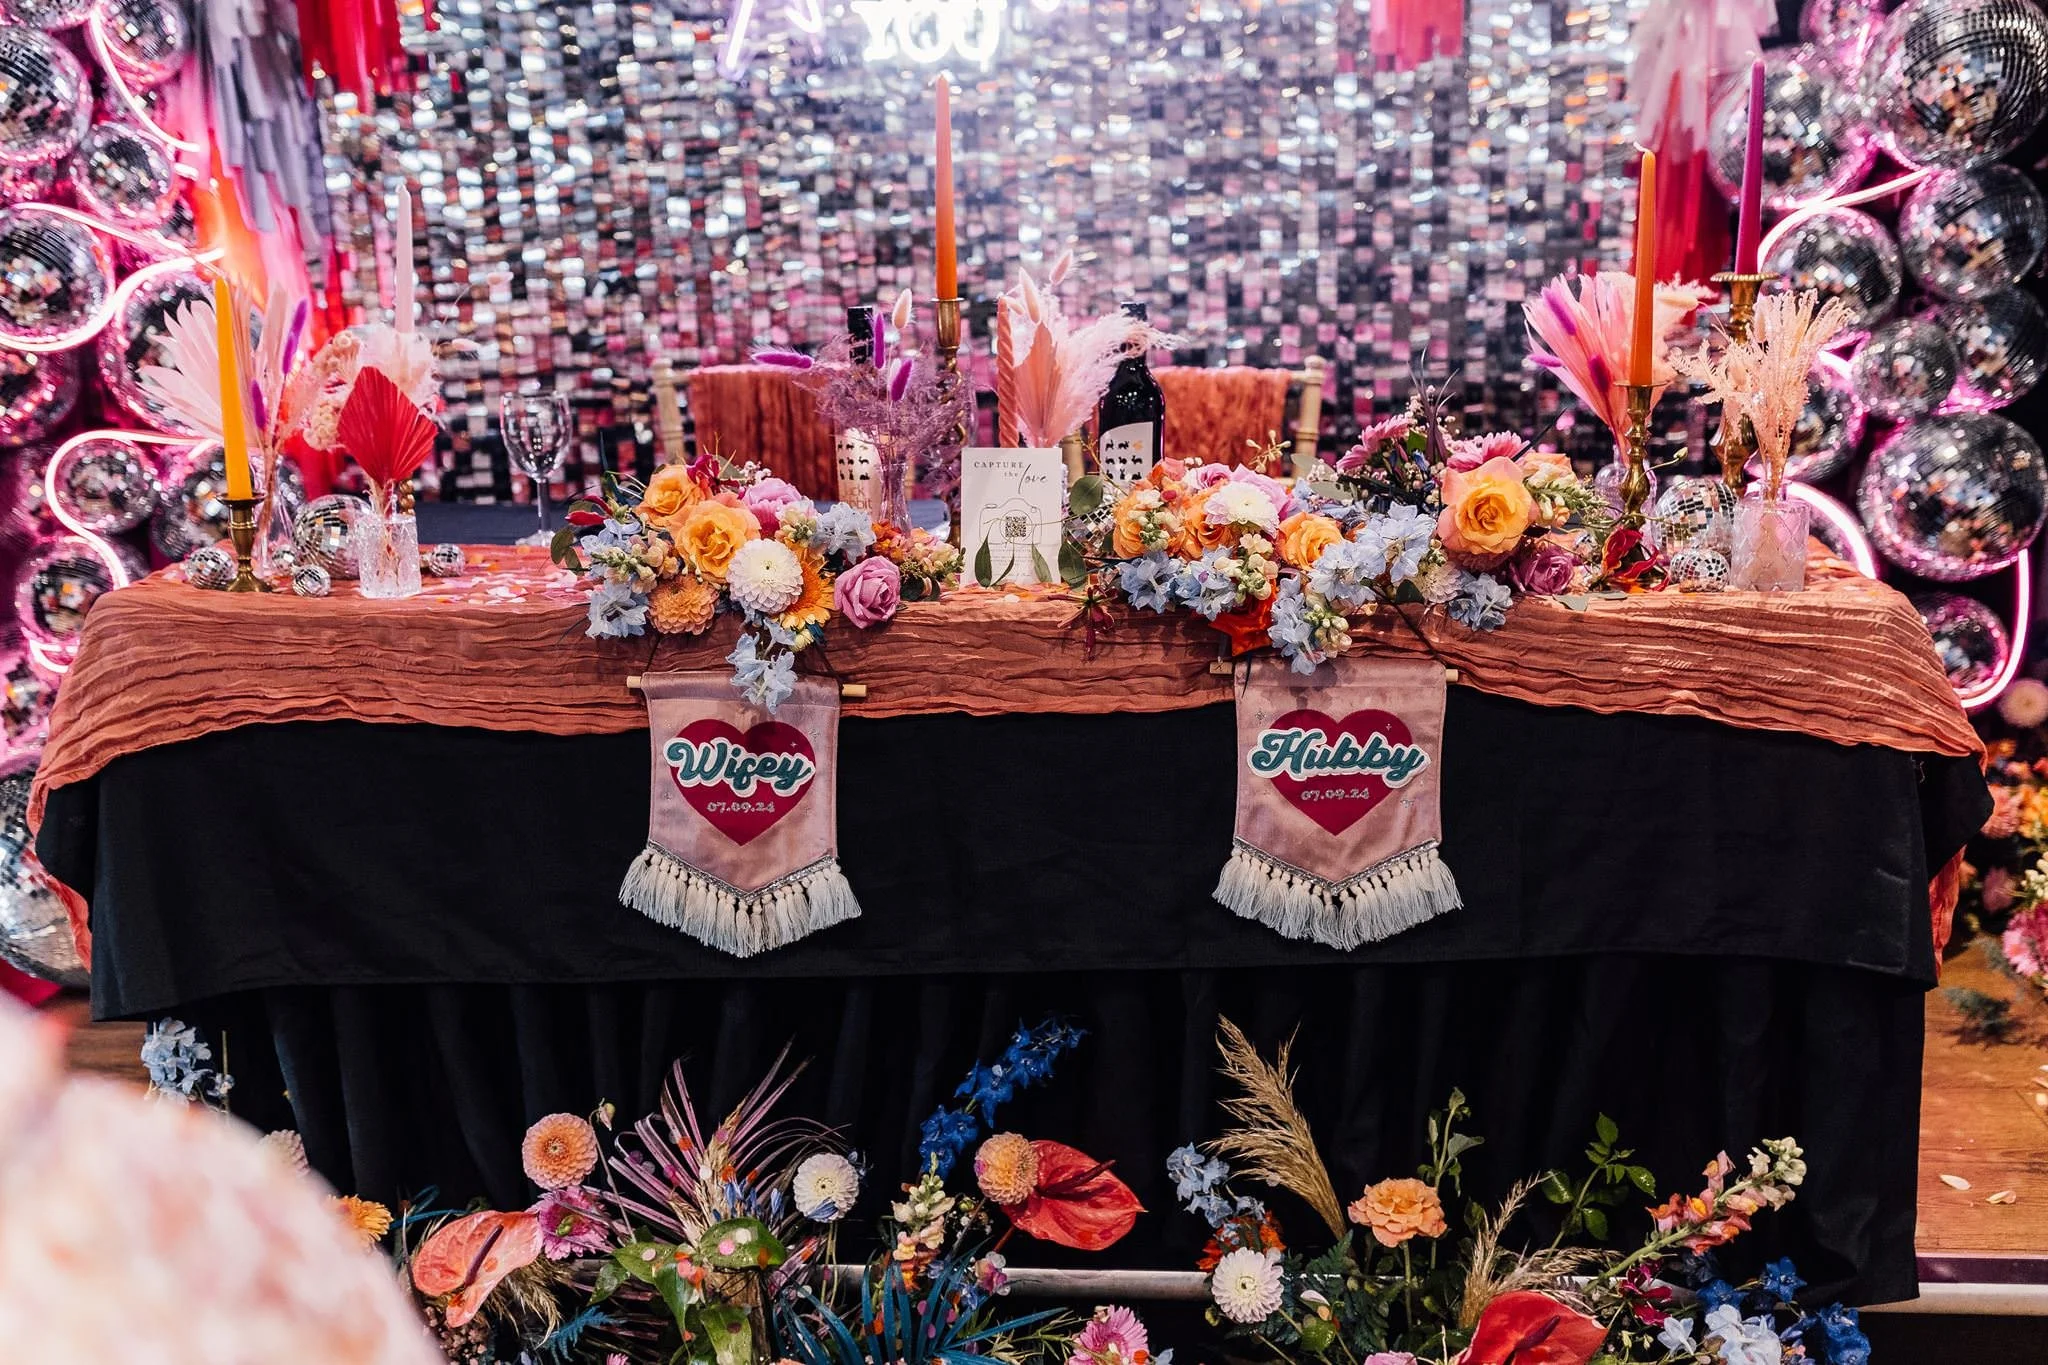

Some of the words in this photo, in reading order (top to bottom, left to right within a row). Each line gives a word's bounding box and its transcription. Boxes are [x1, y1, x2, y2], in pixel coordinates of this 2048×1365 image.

[851, 0, 1006, 72] YOU
[1018, 463, 1047, 494] love
[665, 739, 814, 794] Wifey
[1249, 728, 1428, 785] Hubby
[706, 801, 776, 813] 07.09.24
[1301, 787, 1370, 802] 07.09.24
